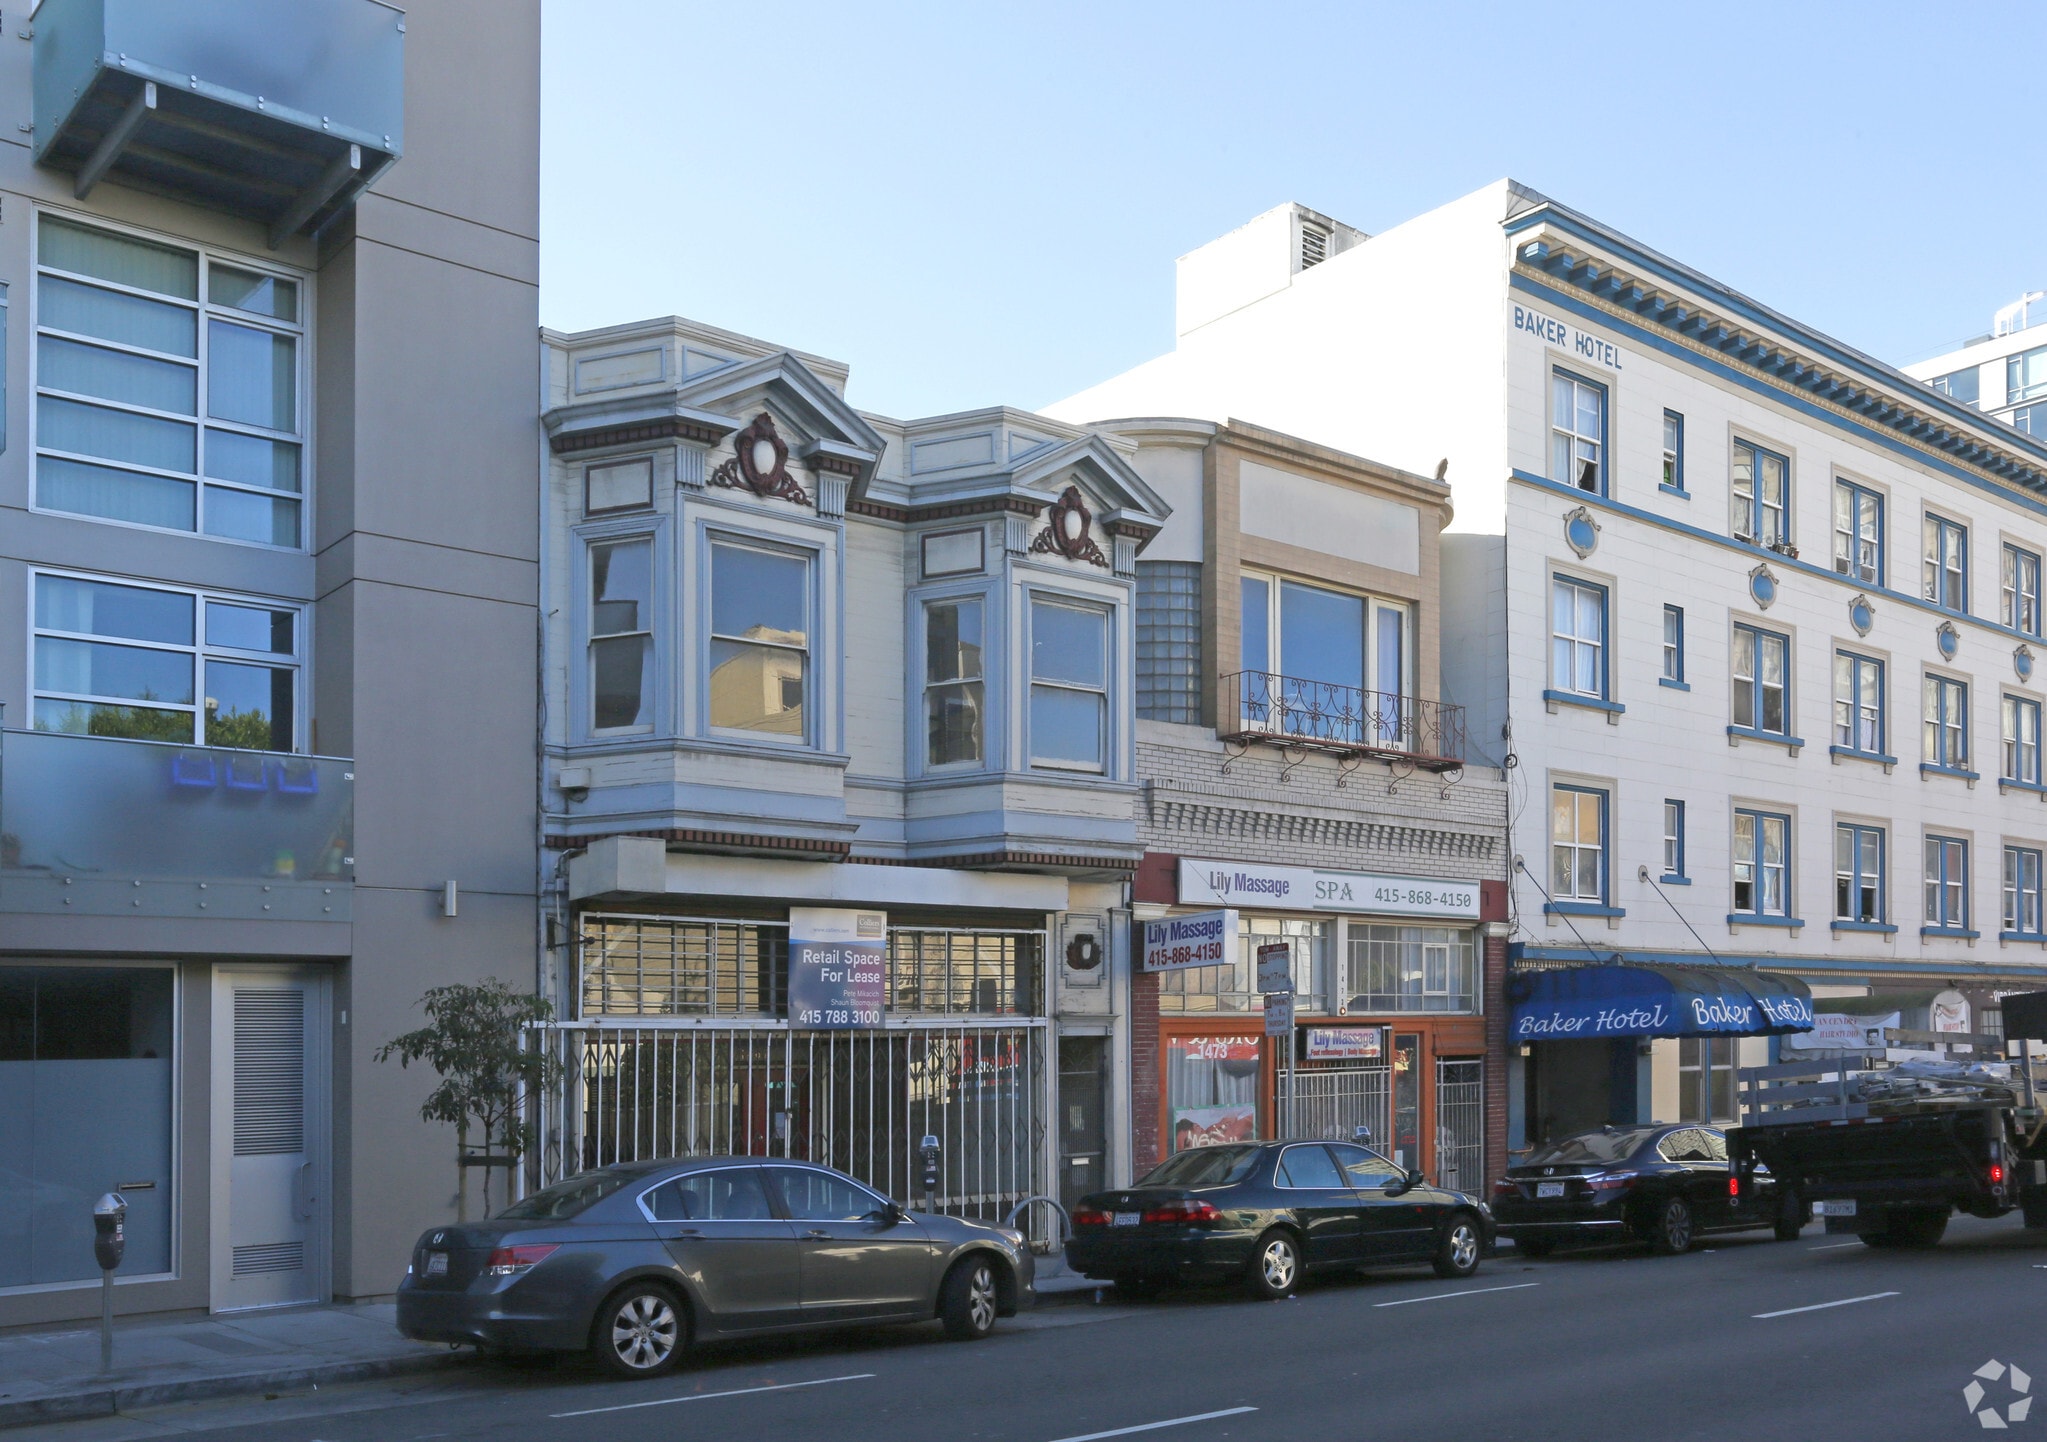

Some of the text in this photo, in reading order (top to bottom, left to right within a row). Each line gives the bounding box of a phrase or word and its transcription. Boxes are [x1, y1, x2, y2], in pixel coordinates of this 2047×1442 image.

[1514, 306, 1622, 370] BAKER HOTEL
[1210, 871, 1472, 908] Lily Massage SPA 415-868-4150
[1148, 919, 1223, 947] Lily Massage
[802, 949, 880, 968] Retail Space
[1148, 942, 1222, 967] 415-868-4150
[821, 968, 880, 983] For Lease
[799, 1010, 880, 1024] 415 788 3100
[1519, 1004, 1668, 1034] Baker Hotel
[1692, 997, 1812, 1025] Baker Hotel
[1197, 1044, 1228, 1059] 1473
[1314, 1030, 1374, 1048] Lily Massage
